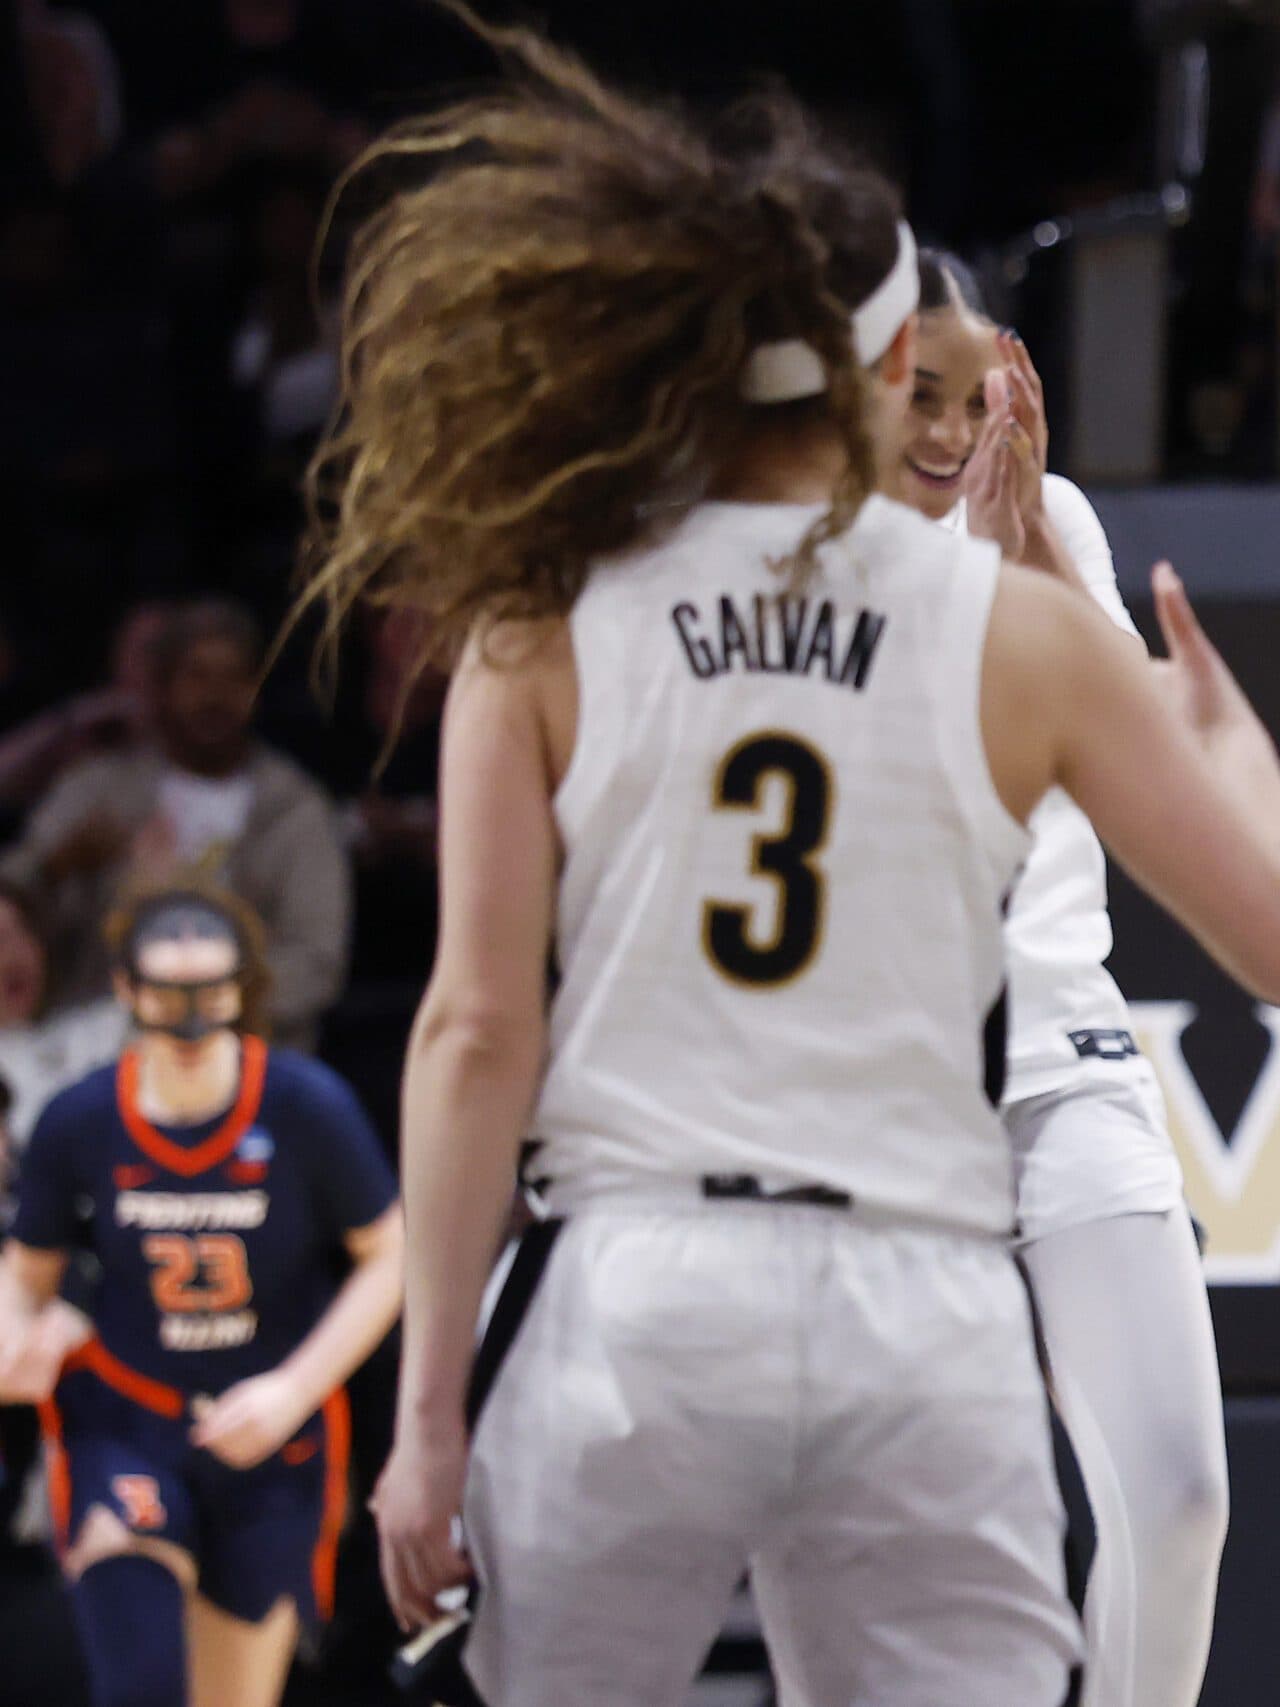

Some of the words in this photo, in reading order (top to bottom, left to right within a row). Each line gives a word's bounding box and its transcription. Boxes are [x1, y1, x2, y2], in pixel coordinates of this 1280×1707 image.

[672, 591, 887, 691] GALVAN
[702, 727, 839, 991] 3
[141, 1231, 253, 1313] 23
